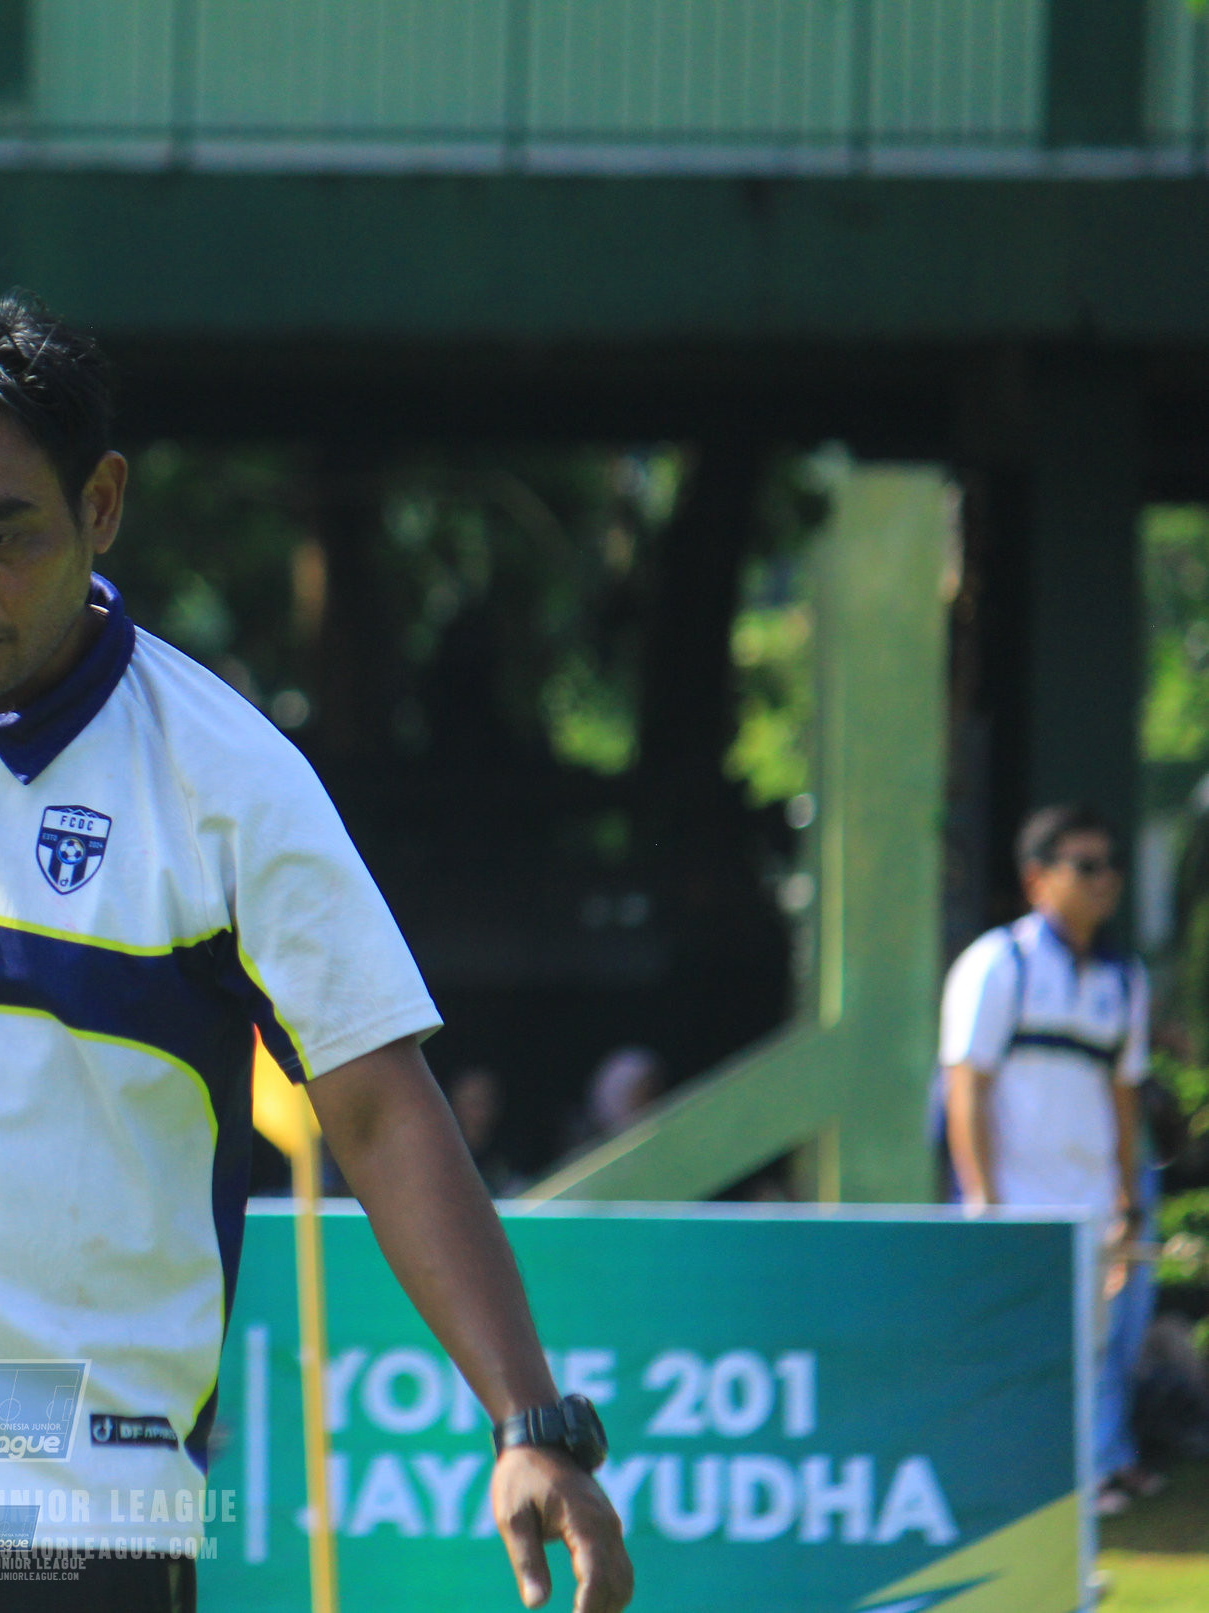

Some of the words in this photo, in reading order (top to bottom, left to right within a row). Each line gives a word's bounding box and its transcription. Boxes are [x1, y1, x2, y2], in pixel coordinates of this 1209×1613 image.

[60, 815, 94, 831] FCDC
[298, 1347, 615, 1435] YOF
[642, 1349, 817, 1438] 201
